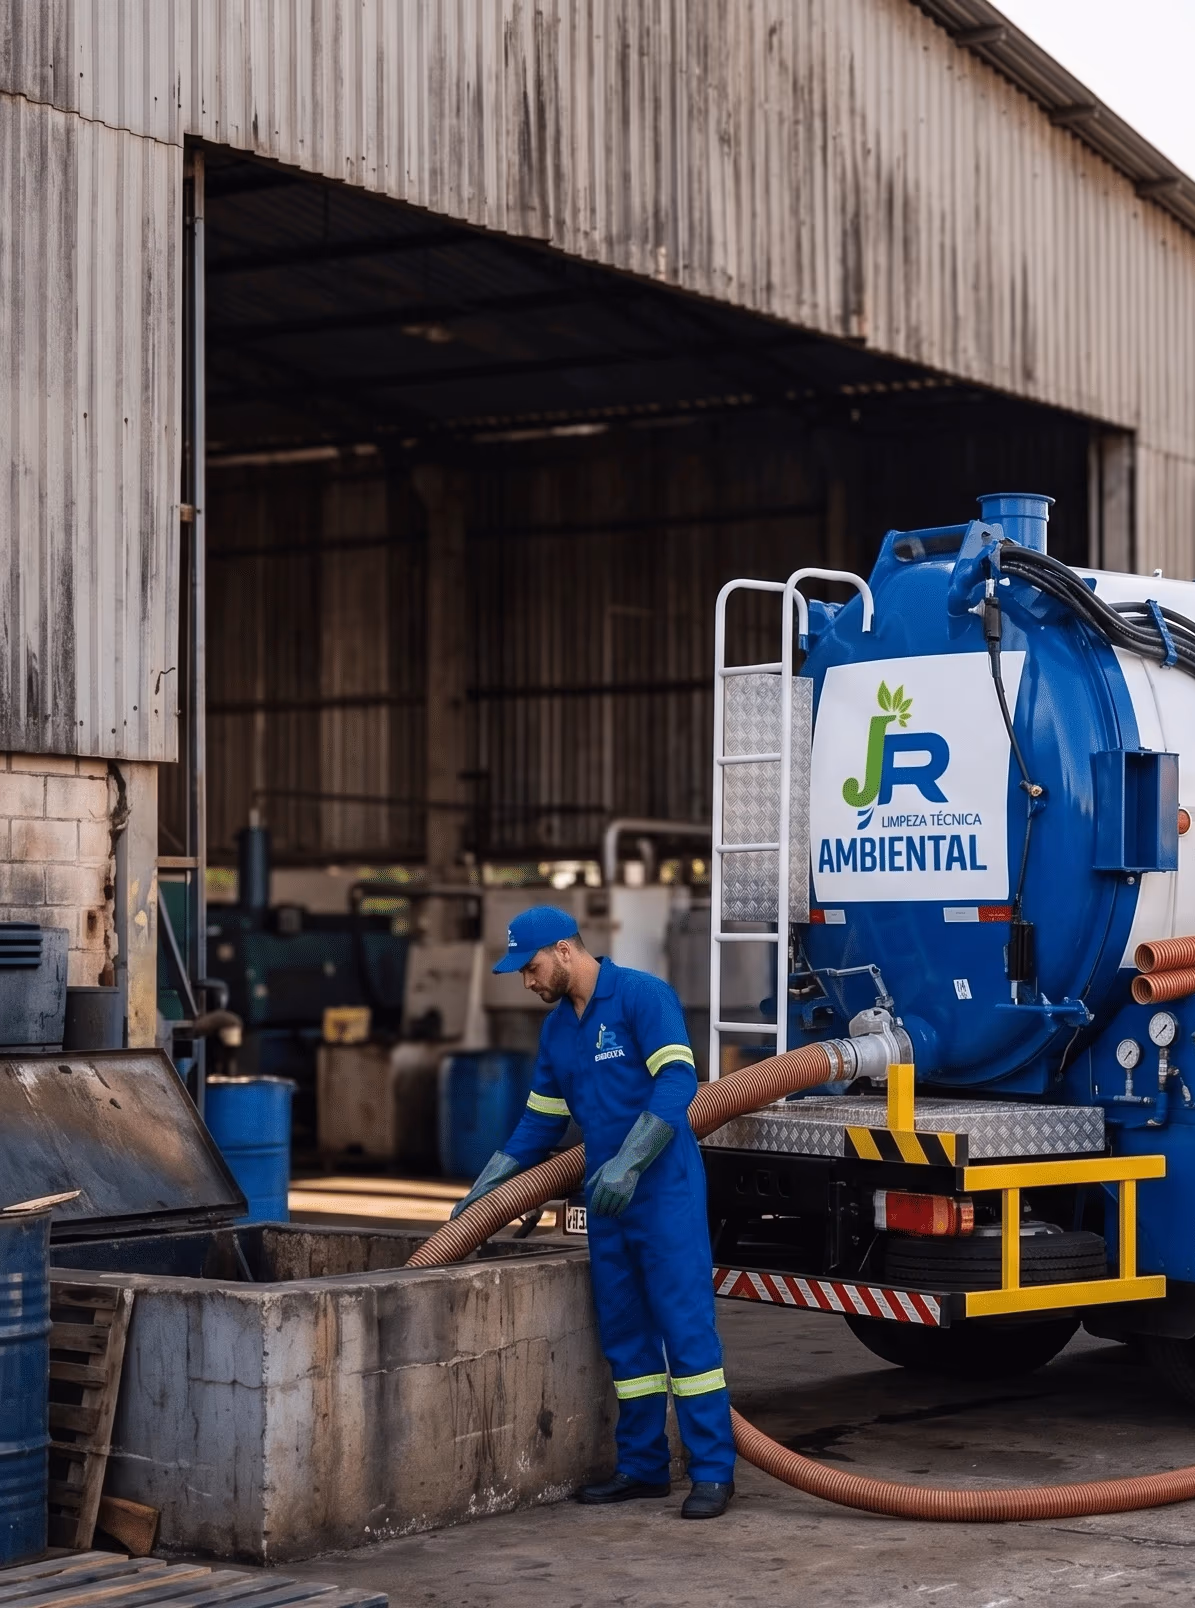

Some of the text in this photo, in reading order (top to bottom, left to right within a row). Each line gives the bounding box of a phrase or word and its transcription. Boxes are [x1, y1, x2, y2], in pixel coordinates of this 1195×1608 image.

[842, 715, 950, 808] JR
[881, 810, 982, 828] LIMPEZA TÉCNICA
[818, 834, 987, 873] AMBIENTAL
